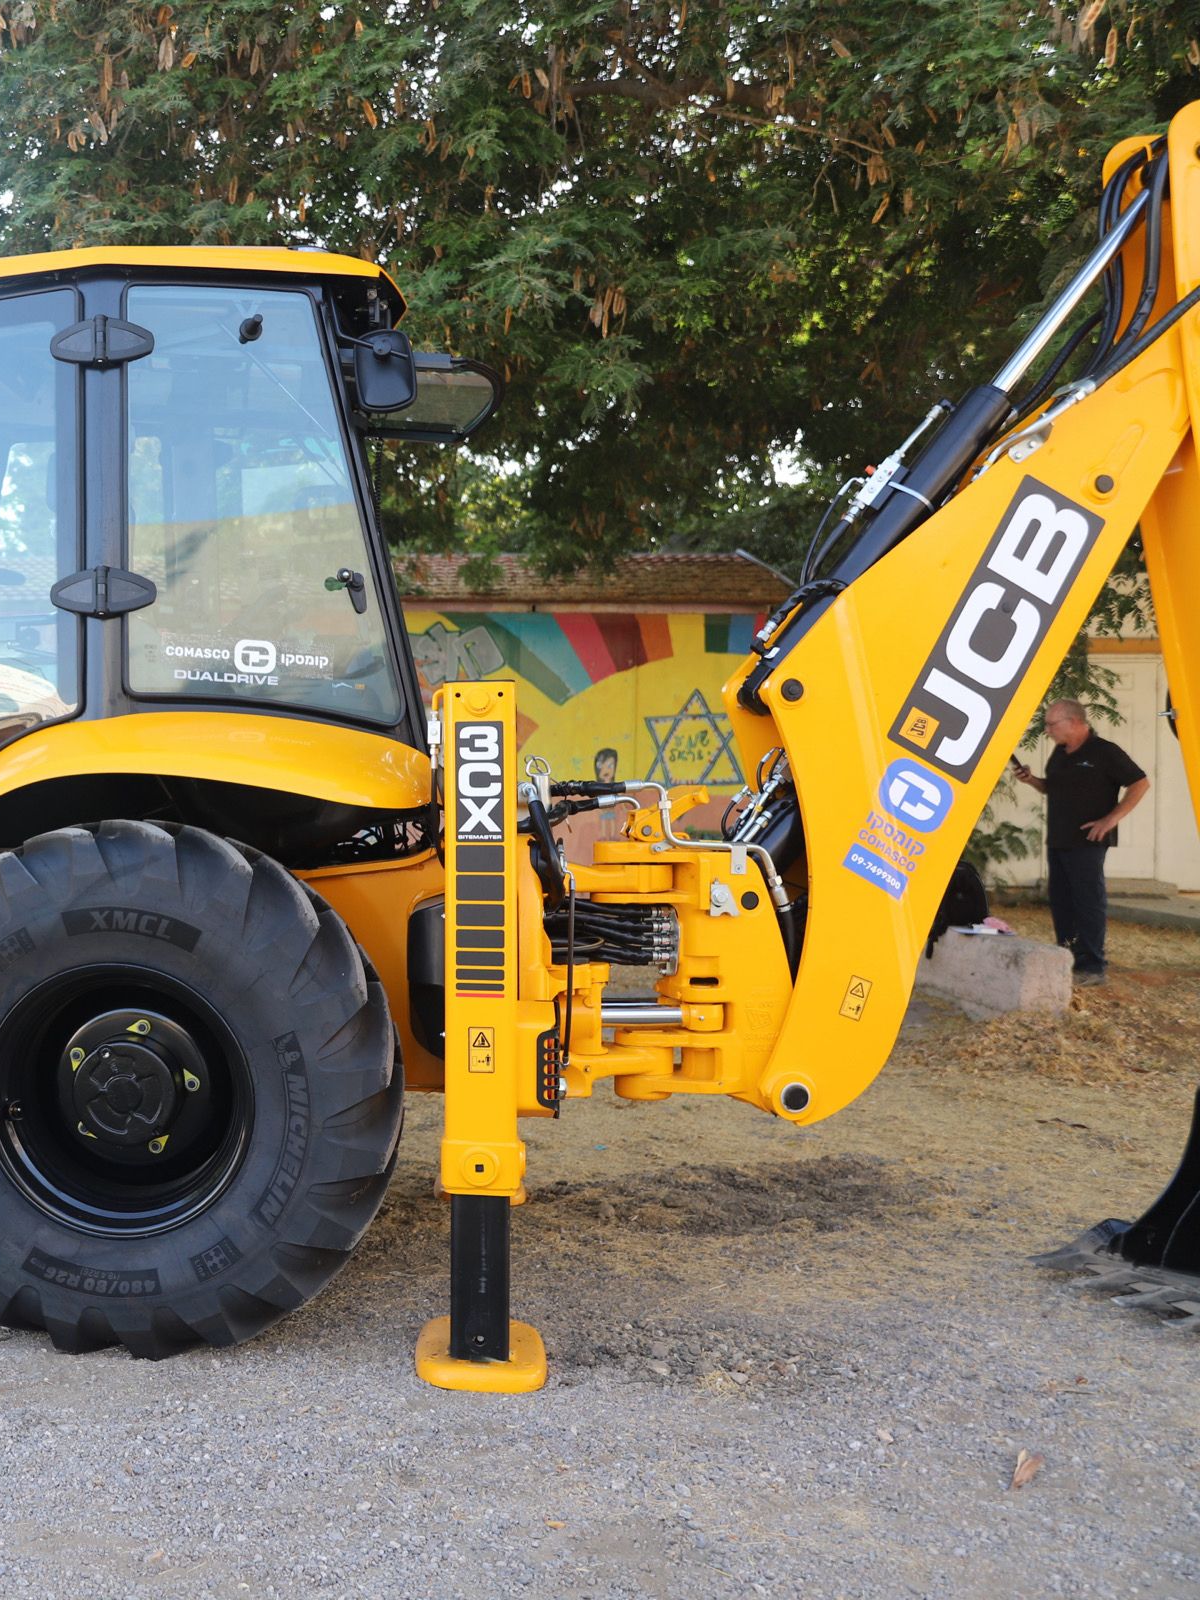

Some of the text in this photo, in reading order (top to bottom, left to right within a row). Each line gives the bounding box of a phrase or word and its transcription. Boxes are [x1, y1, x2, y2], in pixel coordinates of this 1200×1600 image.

[922, 493, 1090, 766] JCB
[165, 646, 230, 660] COMASCO
[280, 654, 329, 670] קומסקו
[173, 669, 279, 686] DUALDRIVE
[910, 718, 927, 736] JCB
[458, 725, 502, 832] 3CX
[866, 811, 926, 856] קומסקו
[858, 829, 916, 872] COMASCO
[850, 853, 901, 890] 09-7499300
[89, 911, 171, 940] XMCL
[259, 1072, 310, 1226] MICHELIN
[43, 1266, 156, 1295] 480/80 R26
